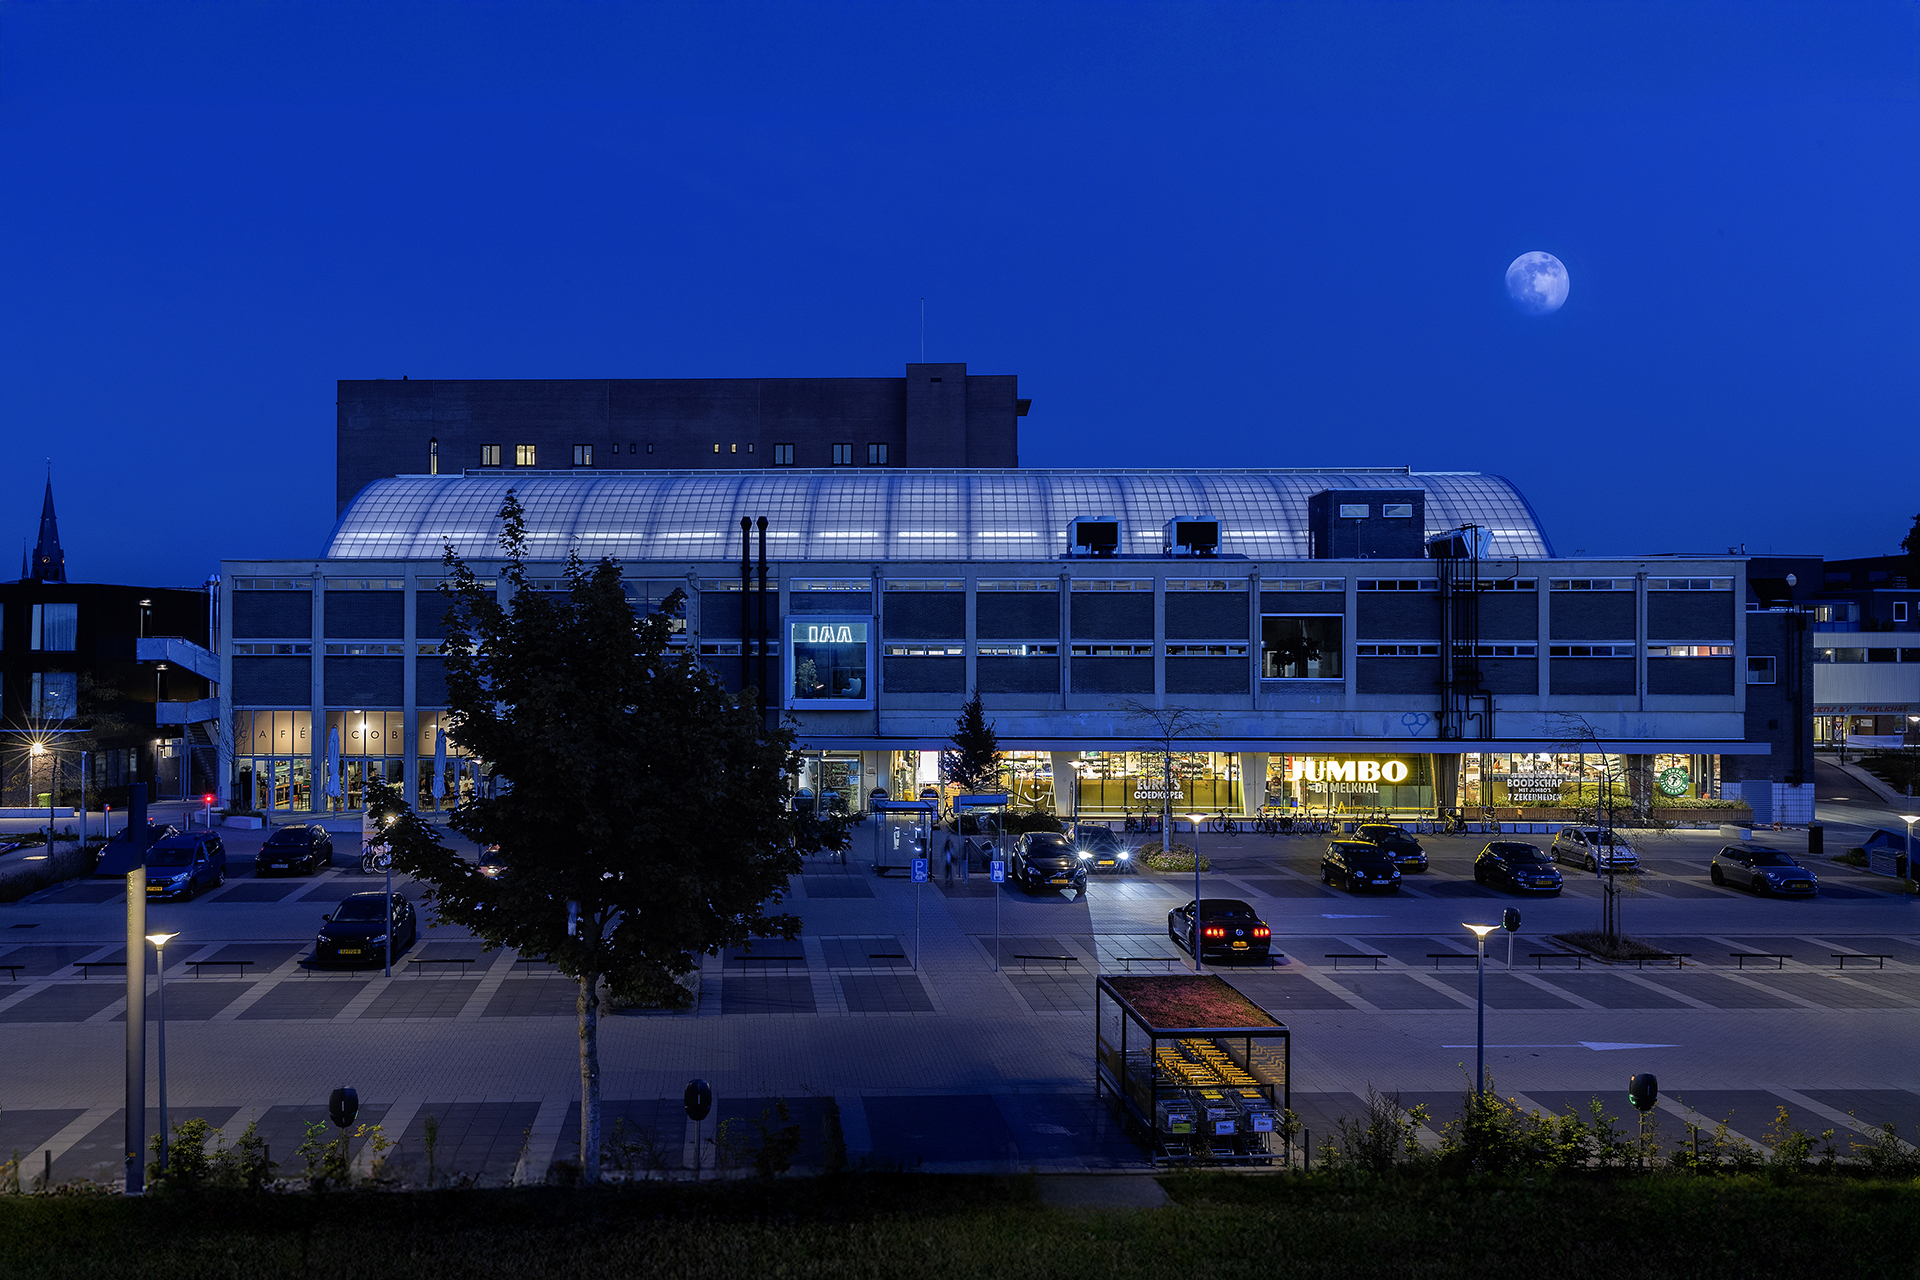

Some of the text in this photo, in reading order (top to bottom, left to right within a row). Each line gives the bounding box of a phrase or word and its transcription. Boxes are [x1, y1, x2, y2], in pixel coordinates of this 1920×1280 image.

[808, 626, 853, 643] IAA
[239, 727, 306, 739] CAFÉ
[1287, 760, 1409, 783] JUMBO
[1506, 778, 1563, 788] BOODSCHAP
[1671, 776, 1678, 786] 7
[1315, 783, 1379, 793] DE MELKHAL
[1133, 790, 1184, 800] GOEDKOPER
[1507, 793, 1563, 801] 7 ZEKERHEDEN
[915, 860, 924, 873] P
